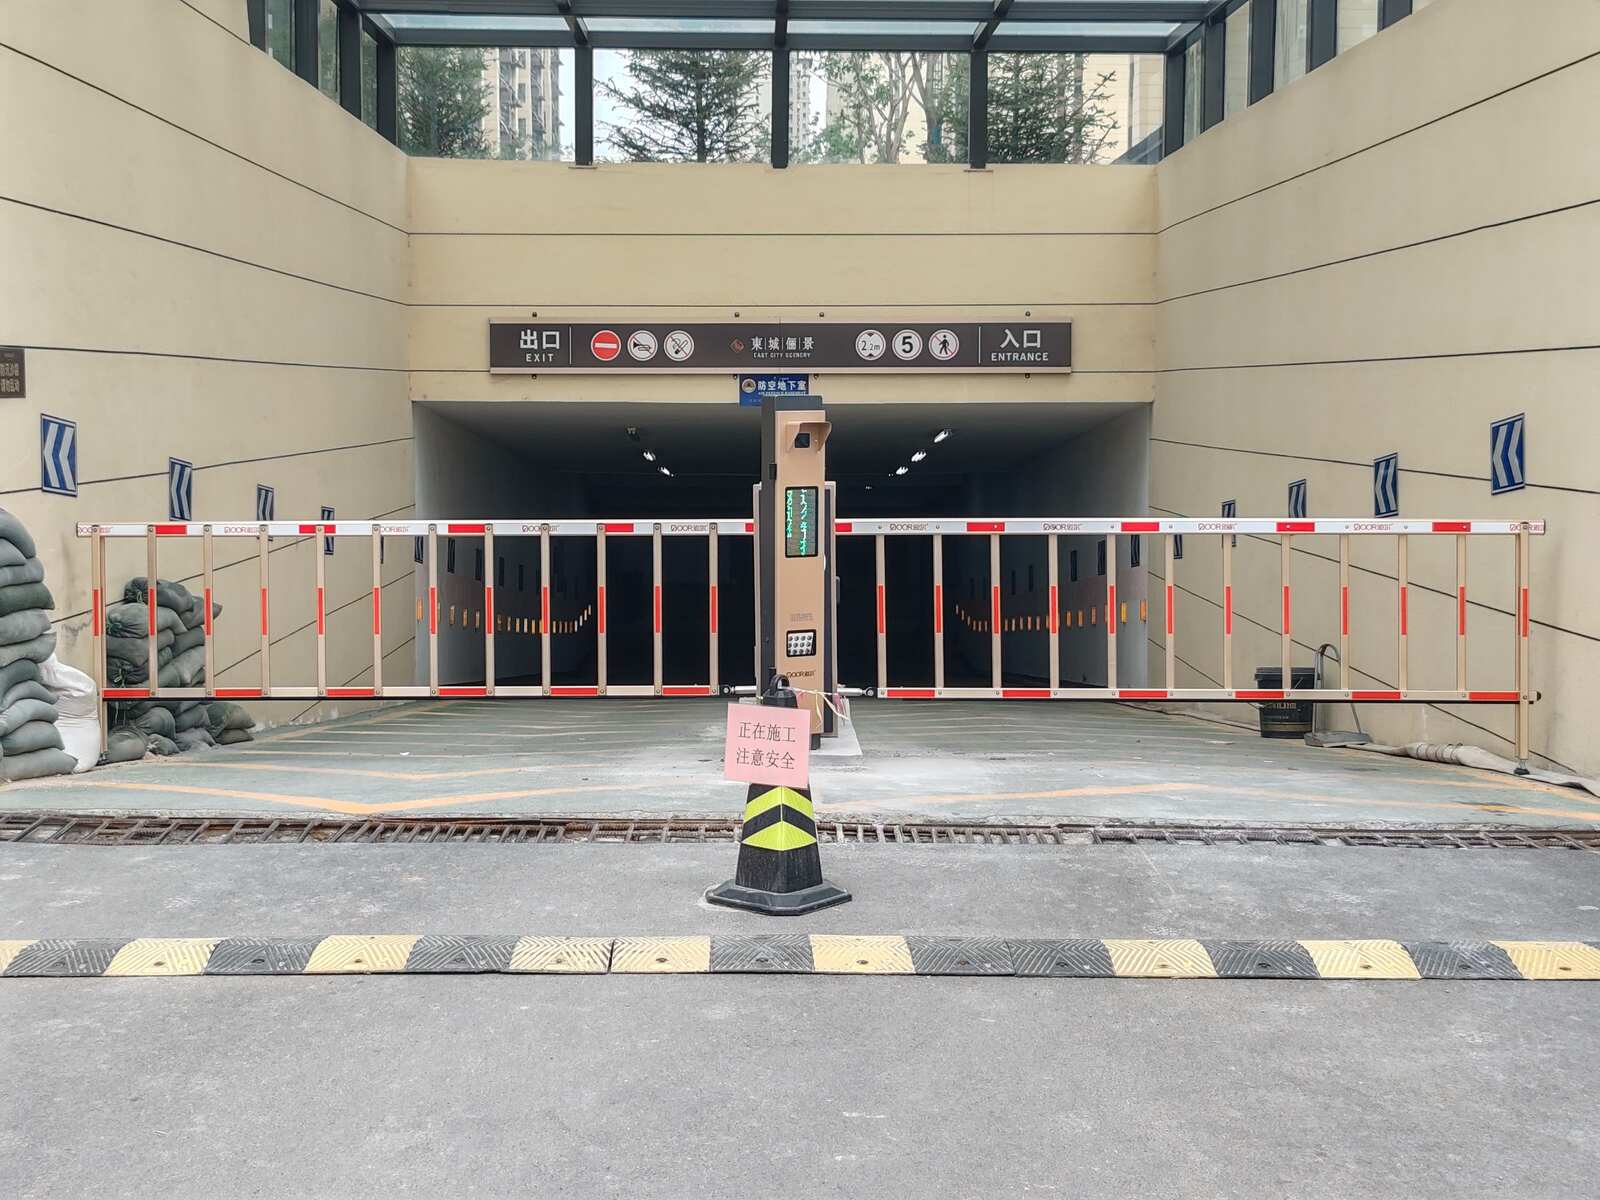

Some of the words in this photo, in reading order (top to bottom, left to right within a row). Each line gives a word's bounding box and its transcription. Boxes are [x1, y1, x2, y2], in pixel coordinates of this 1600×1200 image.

[519, 329, 560, 350] 出口
[901, 335, 914, 353] 5
[1000, 328, 1041, 349] 入口
[525, 353, 554, 362] EXIT
[991, 352, 1049, 362] ENTRANCE
[757, 380, 807, 391] 防空地下室
[738, 721, 796, 743] 正在施工
[736, 747, 795, 770] 注意安全
